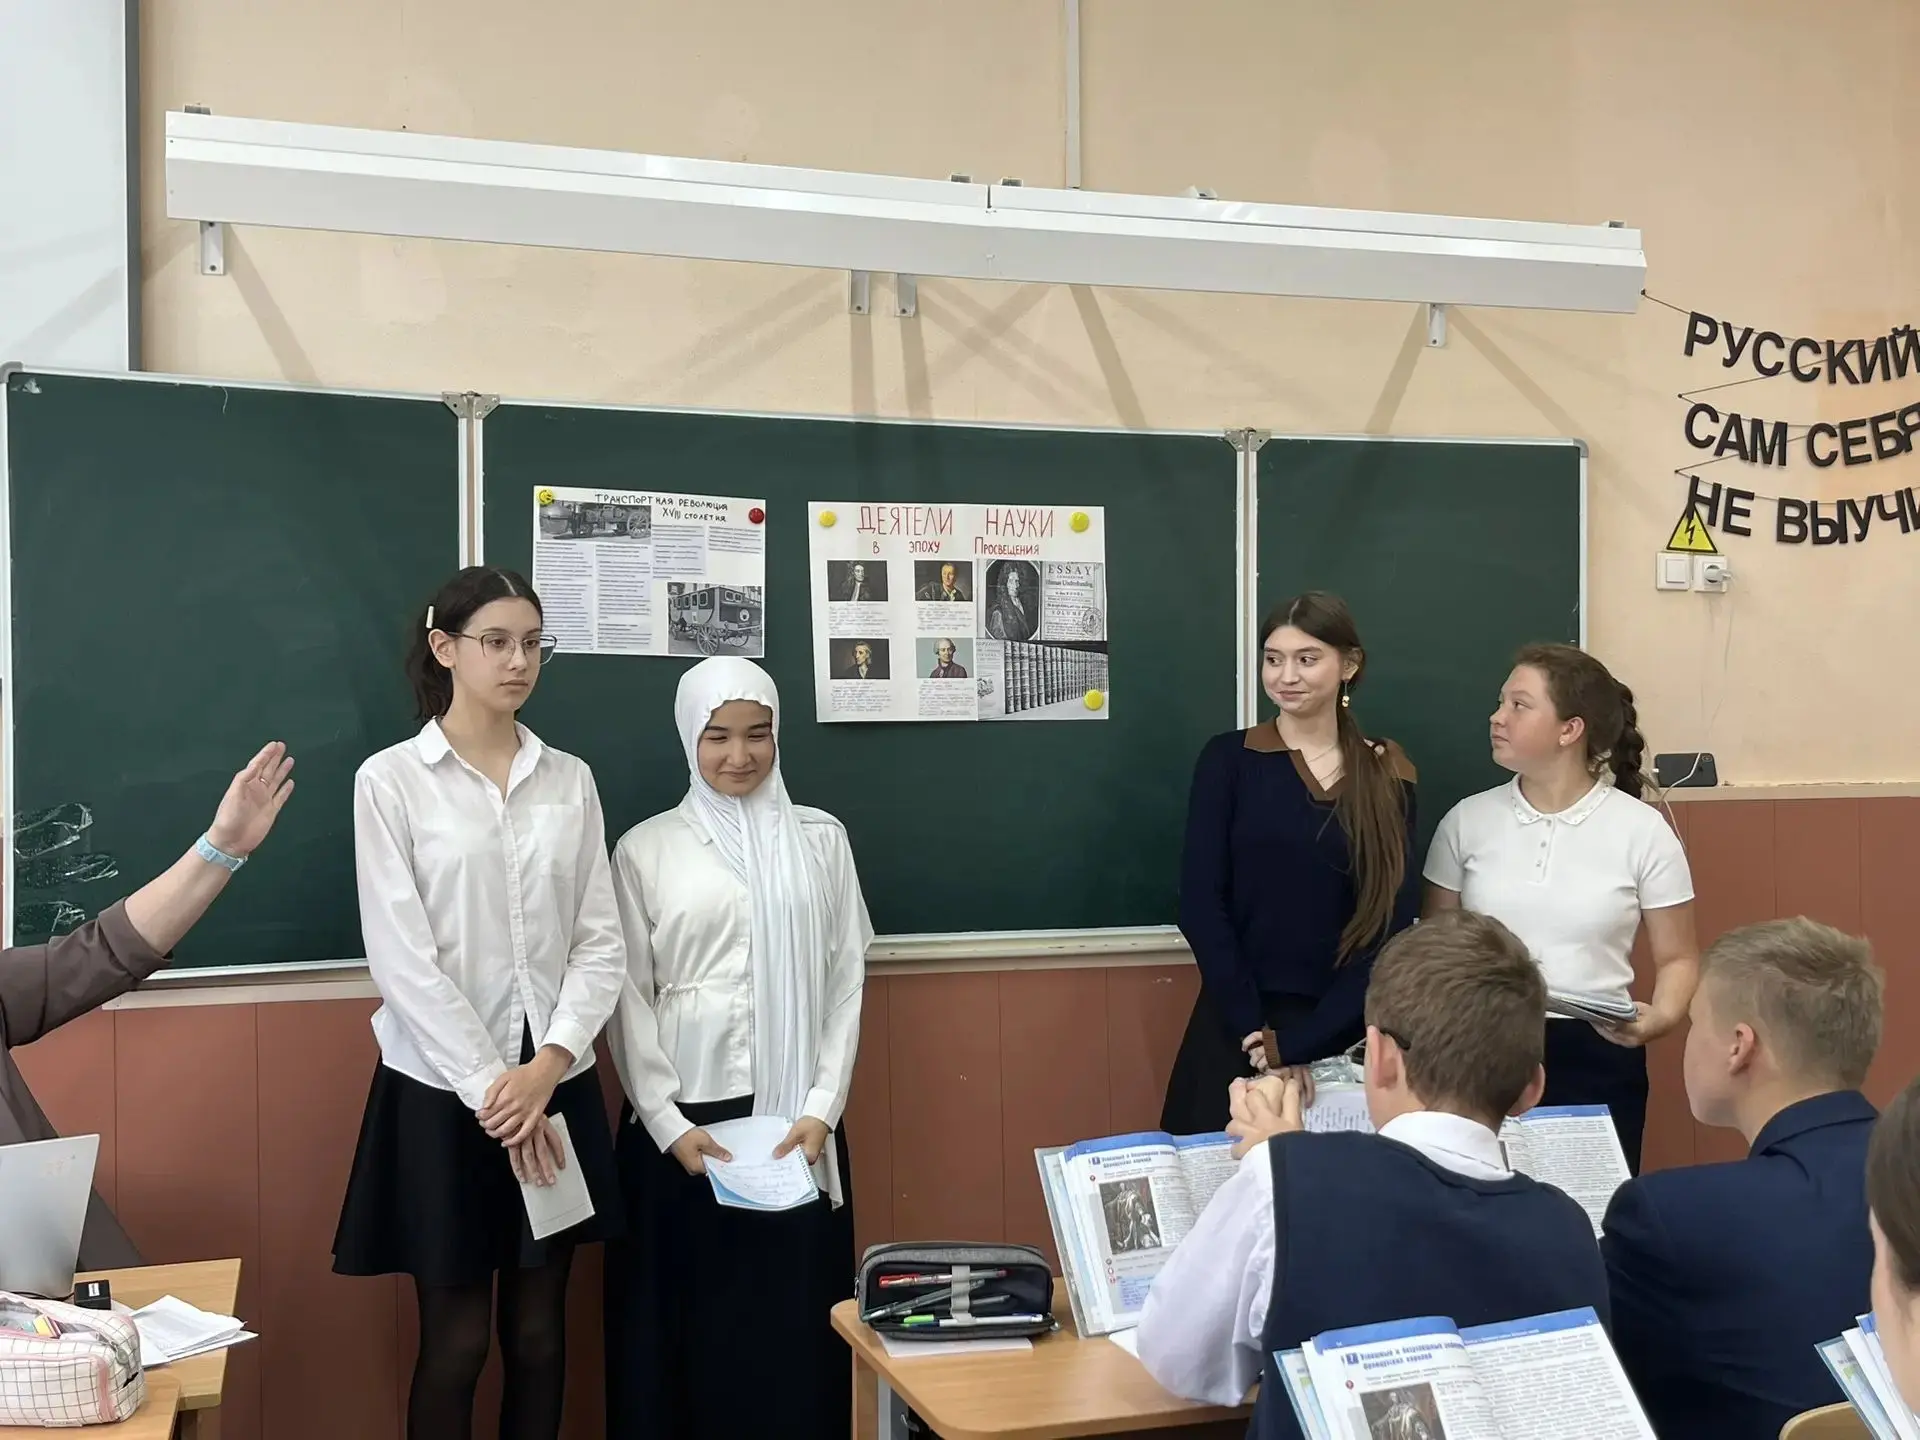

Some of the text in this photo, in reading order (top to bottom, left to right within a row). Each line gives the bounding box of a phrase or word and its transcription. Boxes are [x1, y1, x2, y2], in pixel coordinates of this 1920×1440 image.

[1684, 311, 1920, 385] РУССКИЙ
[1685, 402, 1920, 467] САМ СЕБЯ
[679, 498, 728, 511] РЕВОЛЮЦИЯ
[1686, 475, 1755, 537] НЕ
[684, 513, 727, 523] СТОЛЕТИЯ
[856, 506, 1054, 538] ДЕЯТЕЛИ НАУКИ
[908, 540, 940, 554] ЭПОХУ
[1048, 563, 1092, 576] ESSAY
